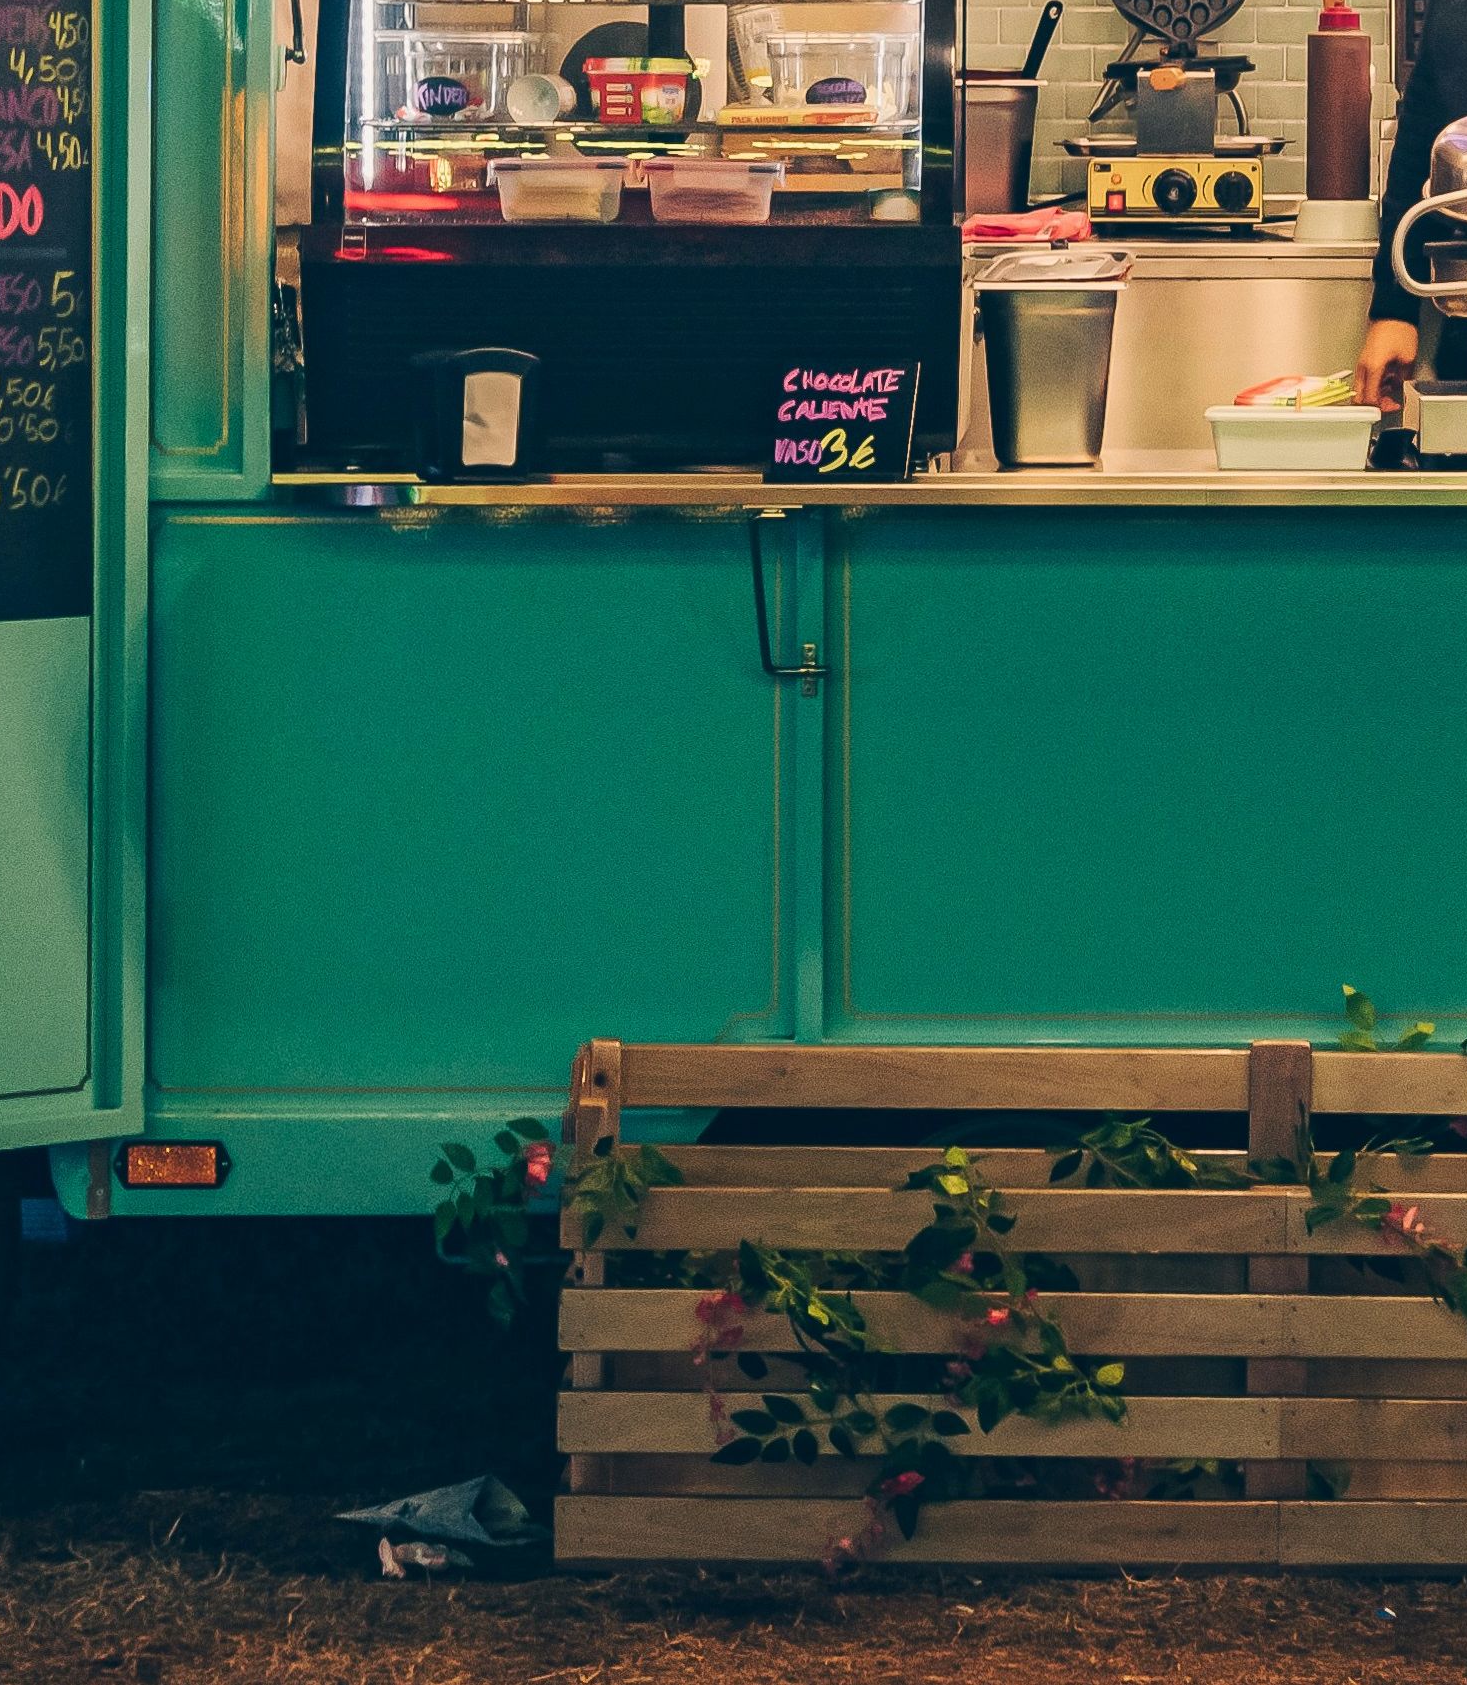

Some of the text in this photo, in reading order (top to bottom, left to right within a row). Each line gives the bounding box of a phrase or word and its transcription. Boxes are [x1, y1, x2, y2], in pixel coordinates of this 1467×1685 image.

[414, 82, 468, 111] KINDER
[784, 368, 905, 394] CHOCOLATE
[777, 397, 889, 422] CALIENTE
[774, 428, 876, 473] VASO 3€
